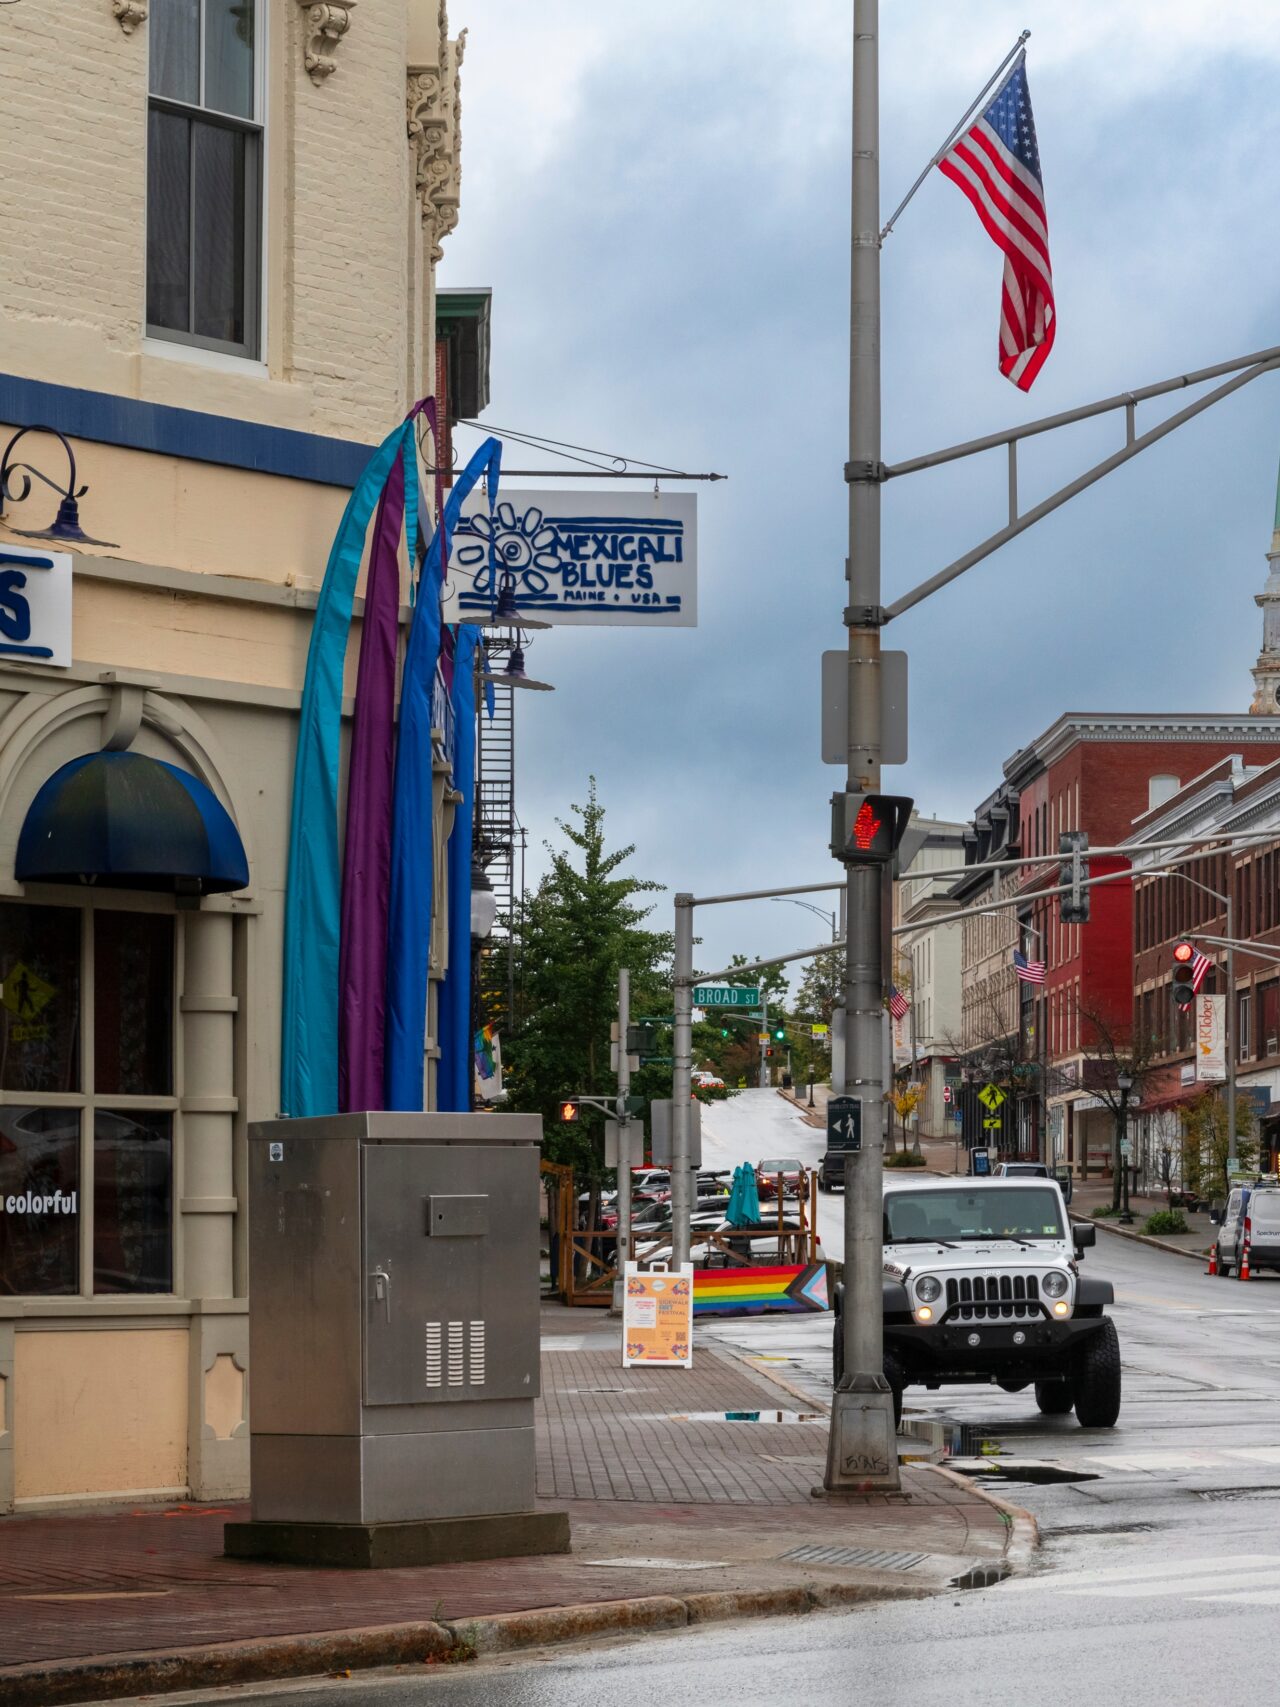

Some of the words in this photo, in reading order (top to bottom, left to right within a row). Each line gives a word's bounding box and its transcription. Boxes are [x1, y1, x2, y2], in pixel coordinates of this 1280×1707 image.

[551, 534, 683, 563] MEXICALI
[562, 562, 654, 589] BLUES
[563, 591, 605, 602] MAINE
[631, 593, 661, 604] USA
[698, 989, 738, 1004] BROAD
[746, 994, 756, 1004] ST
[6, 1189, 77, 1214] colorful
